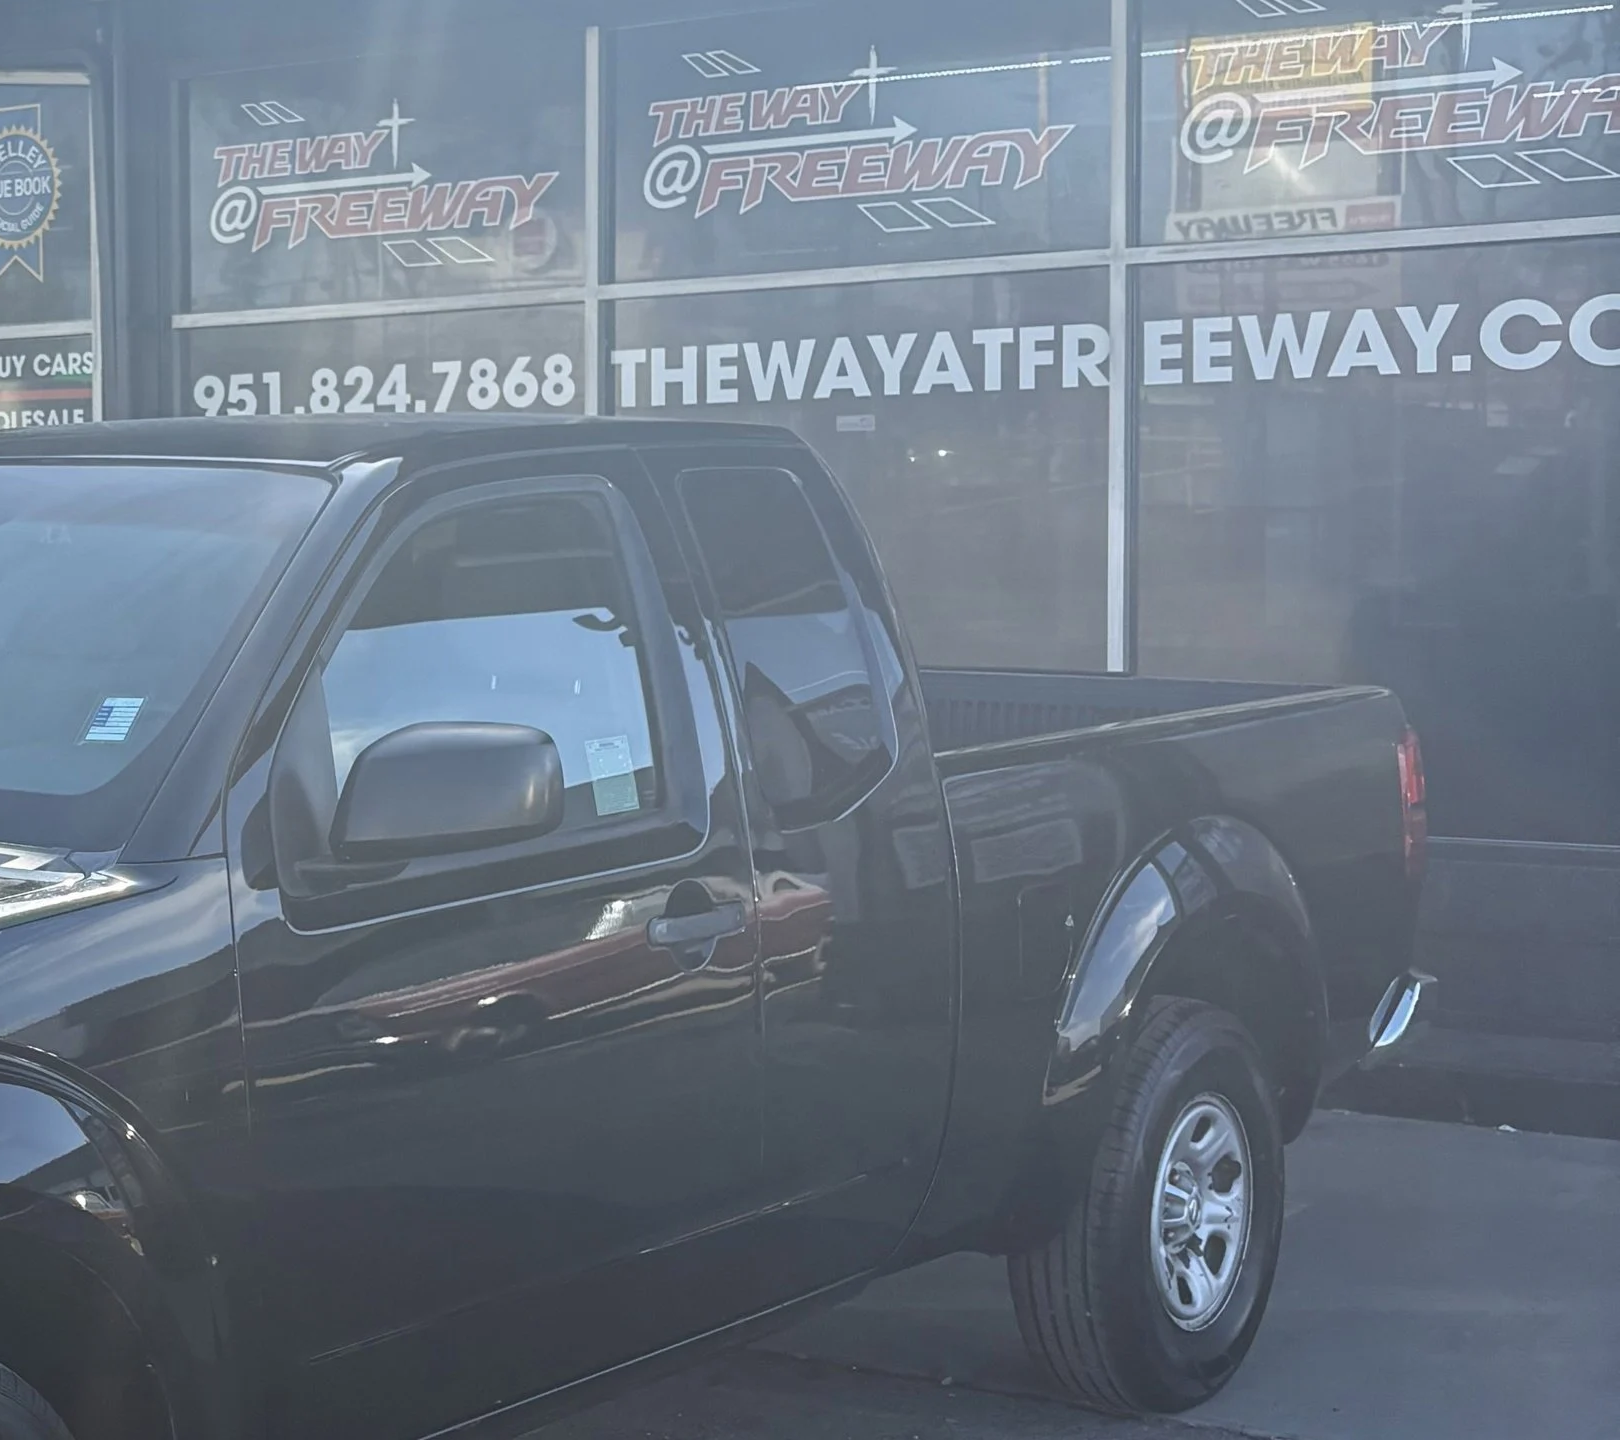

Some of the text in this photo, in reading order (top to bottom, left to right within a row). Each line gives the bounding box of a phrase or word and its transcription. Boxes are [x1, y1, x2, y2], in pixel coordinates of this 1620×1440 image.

[1186, 16, 1459, 96] THE WAY
[649, 81, 864, 148] THE WAY
[14, 175, 52, 197] BOOK
[214, 129, 390, 188] THE WAY
[643, 123, 1077, 219] @FREEWAY
[19, 202, 45, 230] GUIDE
[209, 171, 560, 253] @FREEWAY
[33, 351, 94, 377] CARS
[193, 352, 576, 418] 951.824.7868
